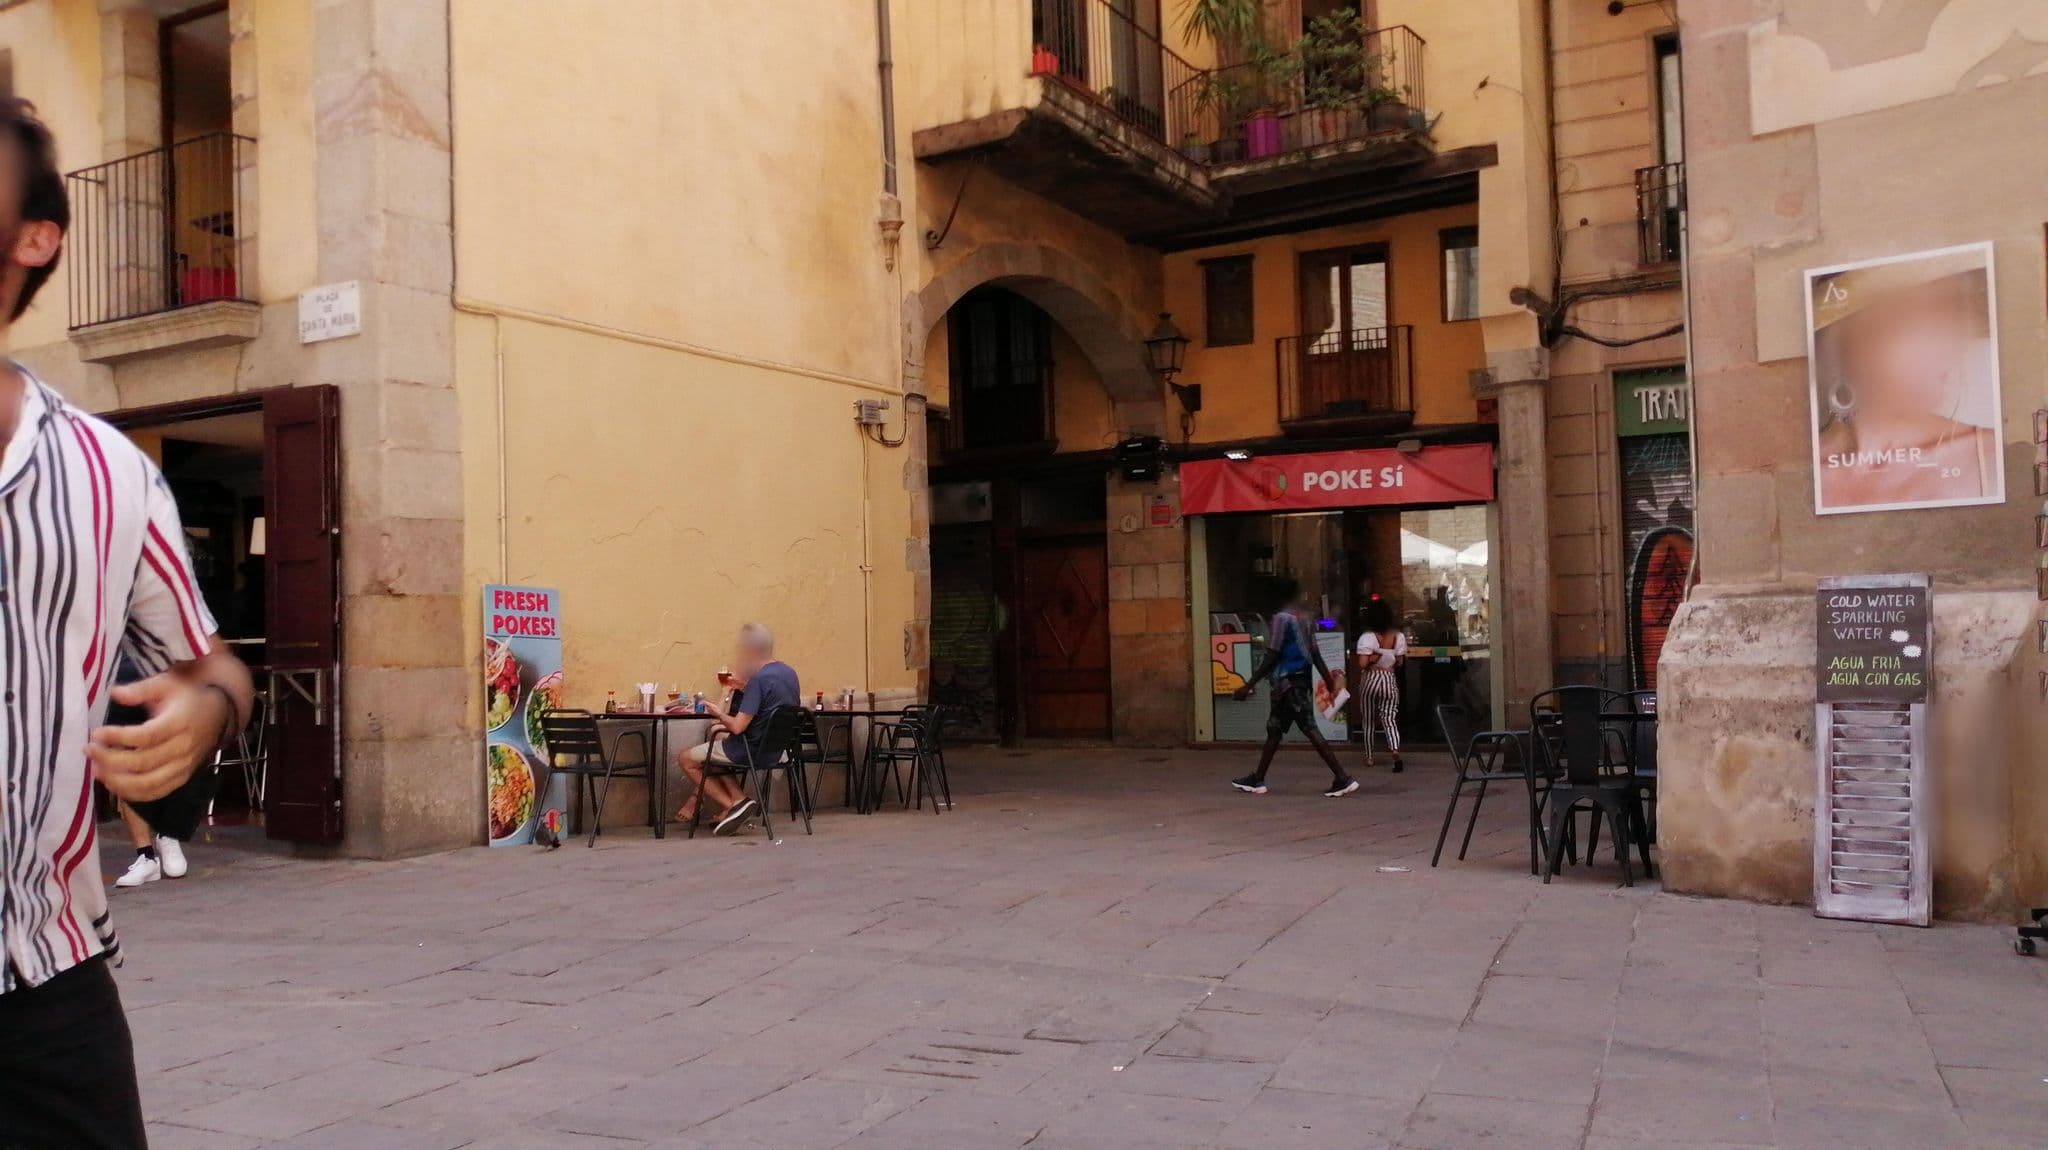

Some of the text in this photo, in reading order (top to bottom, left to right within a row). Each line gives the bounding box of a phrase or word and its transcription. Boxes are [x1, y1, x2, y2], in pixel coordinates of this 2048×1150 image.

[1941, 467, 1961, 478] 20
[1303, 469, 1373, 492] POKE
[494, 590, 549, 612] FRESH
[1829, 594, 1915, 608] COLD WATER
[1831, 610, 1906, 624] SPARKLING
[493, 614, 556, 636] POKES!
[1833, 627, 1883, 640] WATER
[1830, 656, 1865, 669] AGUA
[1829, 672, 1922, 686] AGUA CON GAS
